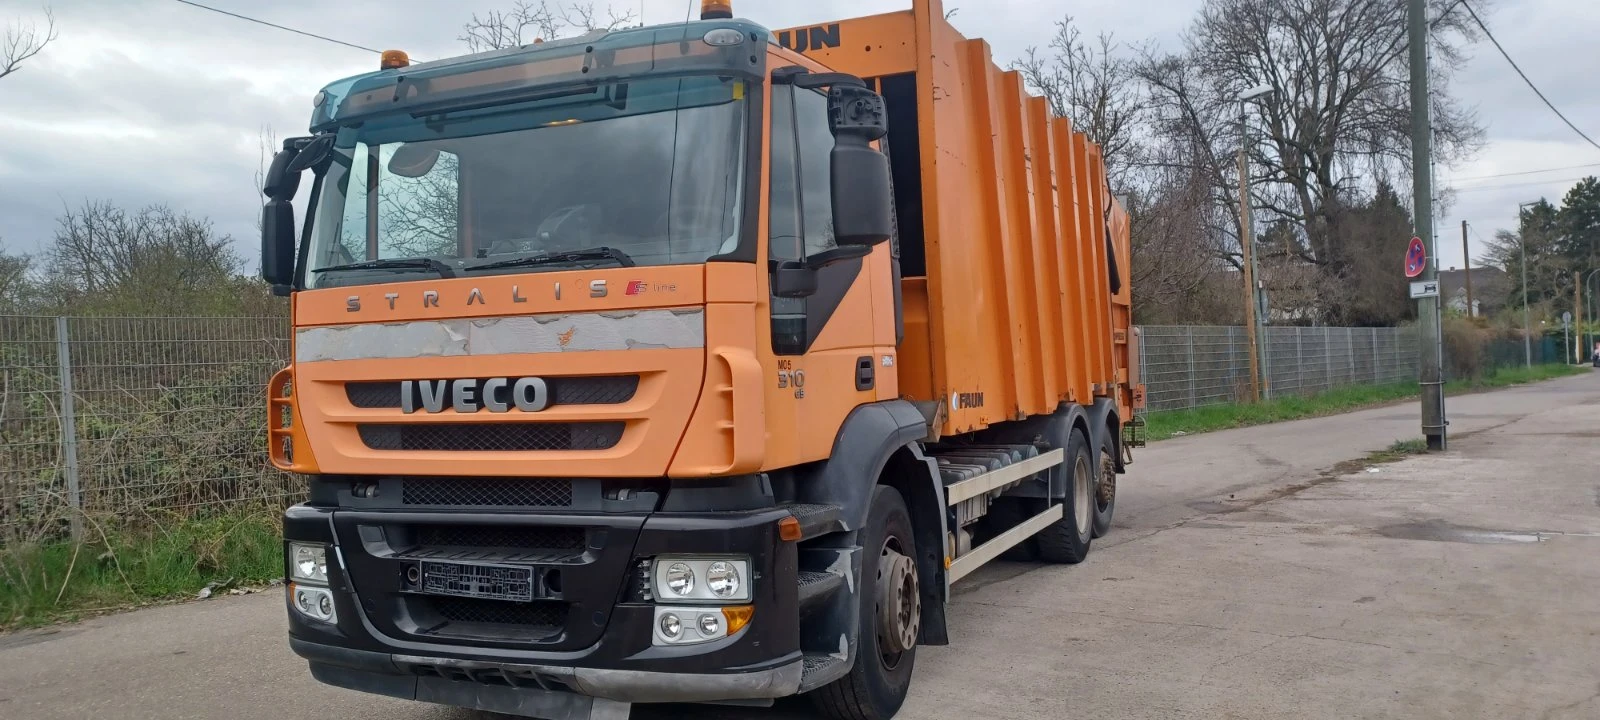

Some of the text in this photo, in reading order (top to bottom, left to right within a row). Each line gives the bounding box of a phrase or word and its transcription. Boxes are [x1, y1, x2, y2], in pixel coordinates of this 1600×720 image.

[779, 24, 840, 53] UN
[346, 279, 608, 312] STRALIS
[653, 282, 677, 292] line
[778, 369, 805, 389] 310
[400, 376, 548, 414] IVECO
[960, 392, 984, 409] FAUN
